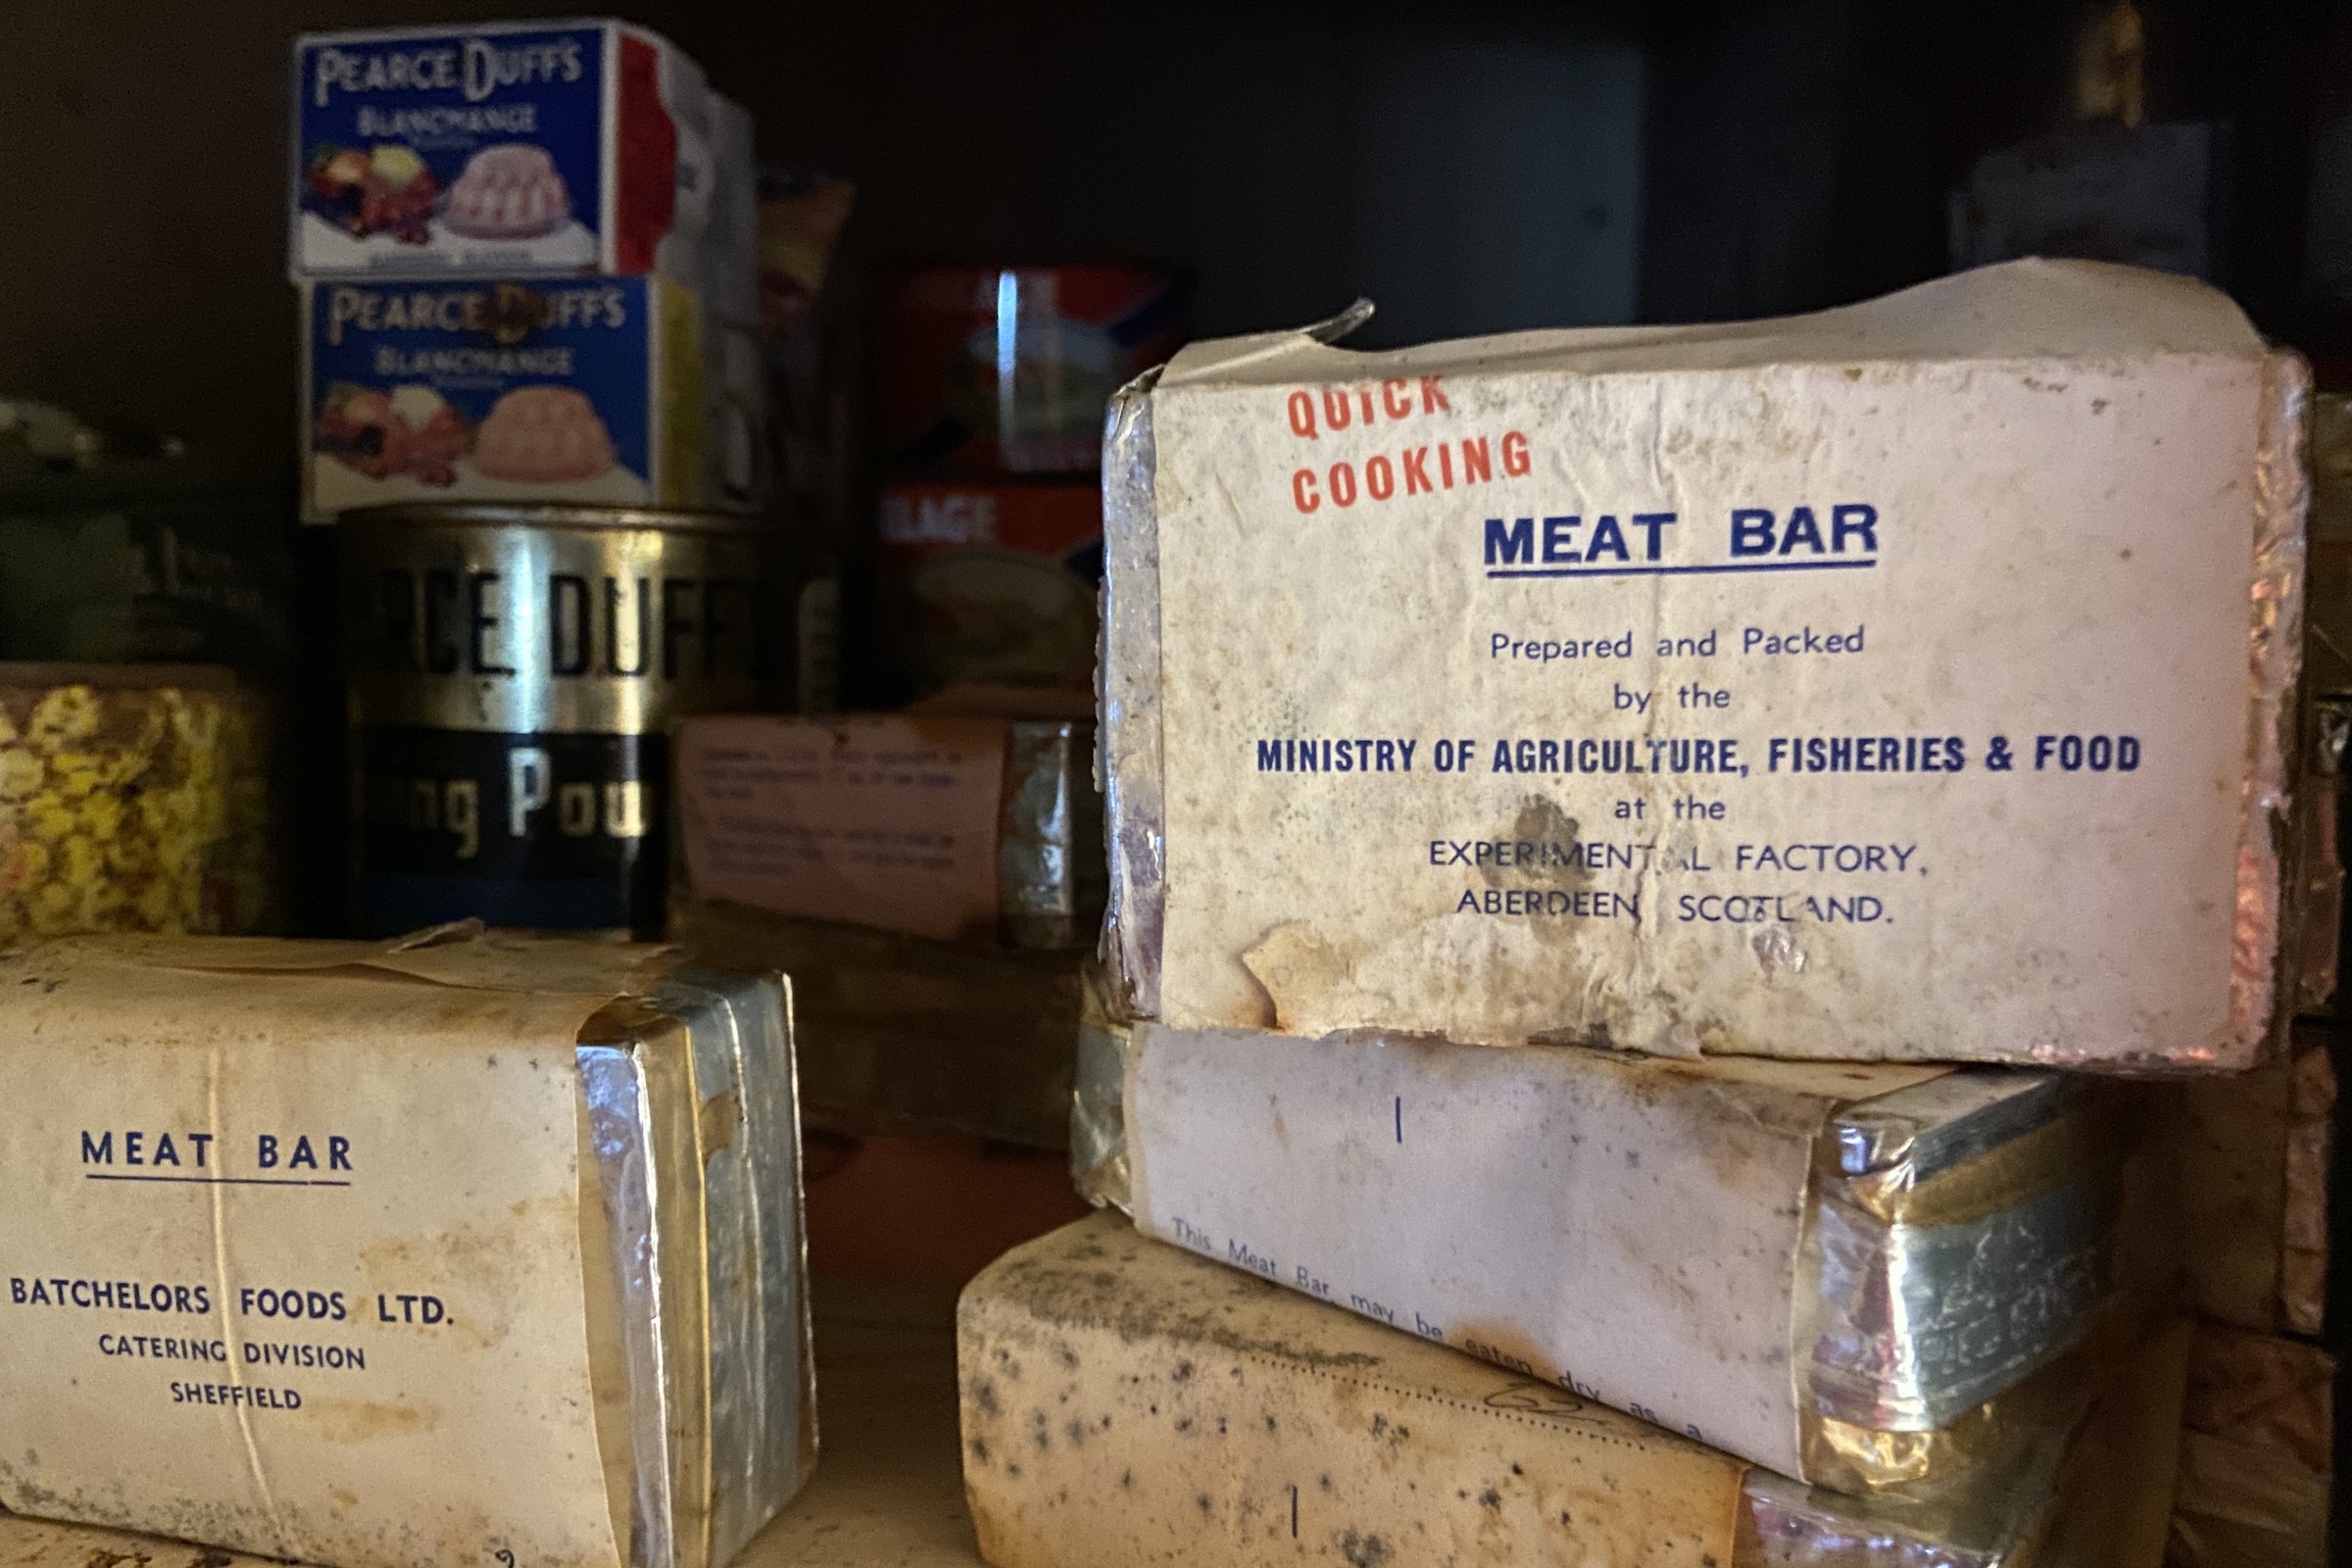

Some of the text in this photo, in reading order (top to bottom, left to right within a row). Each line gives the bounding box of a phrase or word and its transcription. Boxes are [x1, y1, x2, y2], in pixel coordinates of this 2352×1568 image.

[315, 47, 459, 108] PEARCE
[329, 286, 482, 347] PEARCE
[1288, 374, 1450, 440] QUICK
[1292, 430, 1532, 514] COOKING
[1483, 503, 1880, 565] MEAT BAR
[1491, 623, 1865, 663] Prepared and Packed
[1613, 681, 1732, 714] by the
[1256, 734, 2142, 778] MINISTRY OF AGRICULTURE, FISHERIES & FOOD
[1614, 795, 1727, 821] at the
[1736, 843, 1929, 877] FACTORY,
[80, 1130, 354, 1171] MEAT BAR
[10, 1277, 455, 1326] BATCHELORS FOODS LTD.
[1172, 1216, 1212, 1250] This
[1228, 1238, 1277, 1276] Meat
[1296, 1264, 1330, 1296] Bar
[1350, 1293, 1395, 1323] may
[1415, 1310, 1445, 1345] be
[99, 1333, 367, 1371] CATERING DIVISION
[171, 1381, 303, 1410] SHEFFIELD
